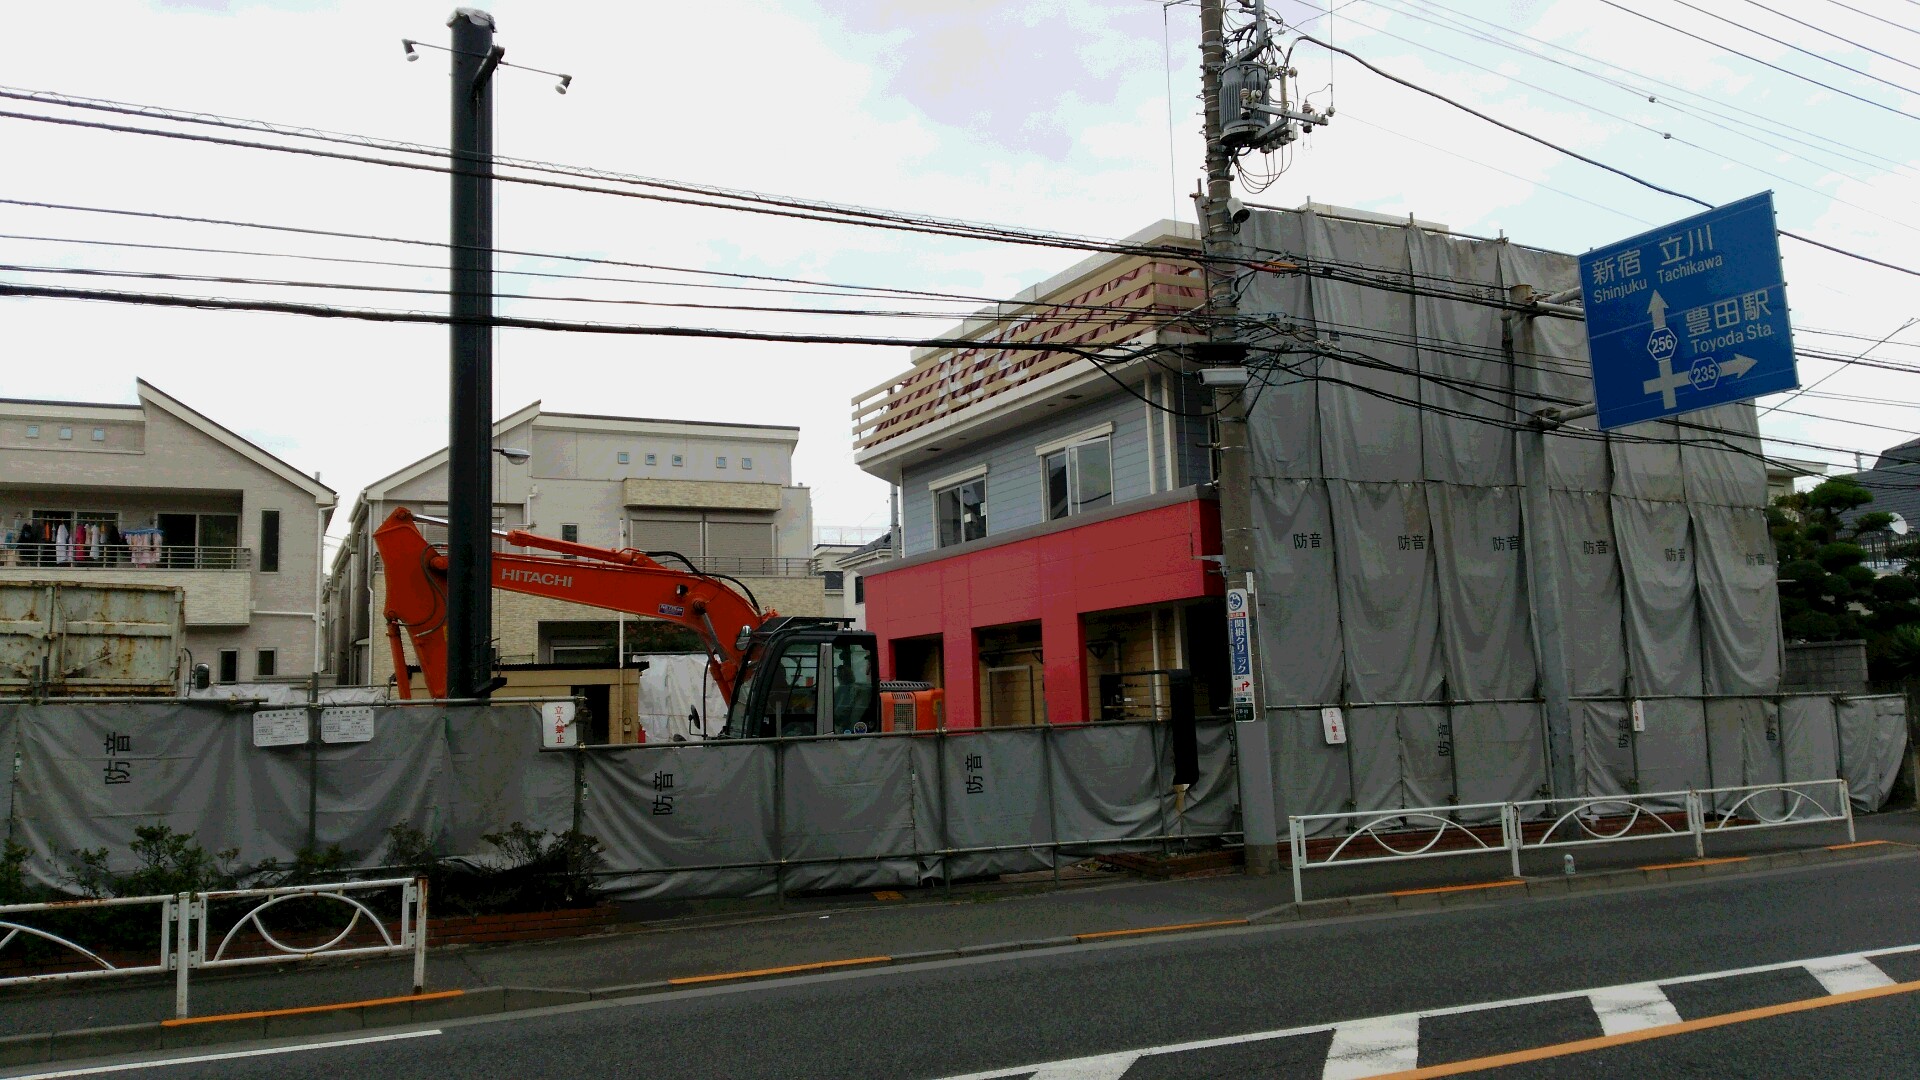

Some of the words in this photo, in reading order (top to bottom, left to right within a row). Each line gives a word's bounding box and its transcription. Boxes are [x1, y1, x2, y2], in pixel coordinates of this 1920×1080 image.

[1592, 249, 1641, 286] 新宿
[1659, 224, 1714, 266] 立川
[1593, 278, 1648, 304] Shinjuku
[1656, 253, 1723, 284] Tachikawa
[1686, 289, 1772, 338] 豊田駅
[1651, 335, 1674, 353] 256
[1690, 331, 1744, 354] Toyoda
[1746, 324, 1774, 340] Sta.
[1693, 366, 1716, 383] 235
[1293, 532, 1322, 550] 防音
[1397, 534, 1426, 551] 防音
[1492, 534, 1520, 551] 防音
[1583, 540, 1609, 555] 防音
[1745, 552, 1766, 566] 防音
[501, 568, 573, 588] HITACHI
[555, 705, 565, 744] 立入禁止
[1437, 722, 1449, 757] 防音
[1618, 717, 1629, 748] 防音
[104, 731, 130, 784] 防音
[965, 753, 983, 794] 防音
[652, 770, 673, 815] 防音
